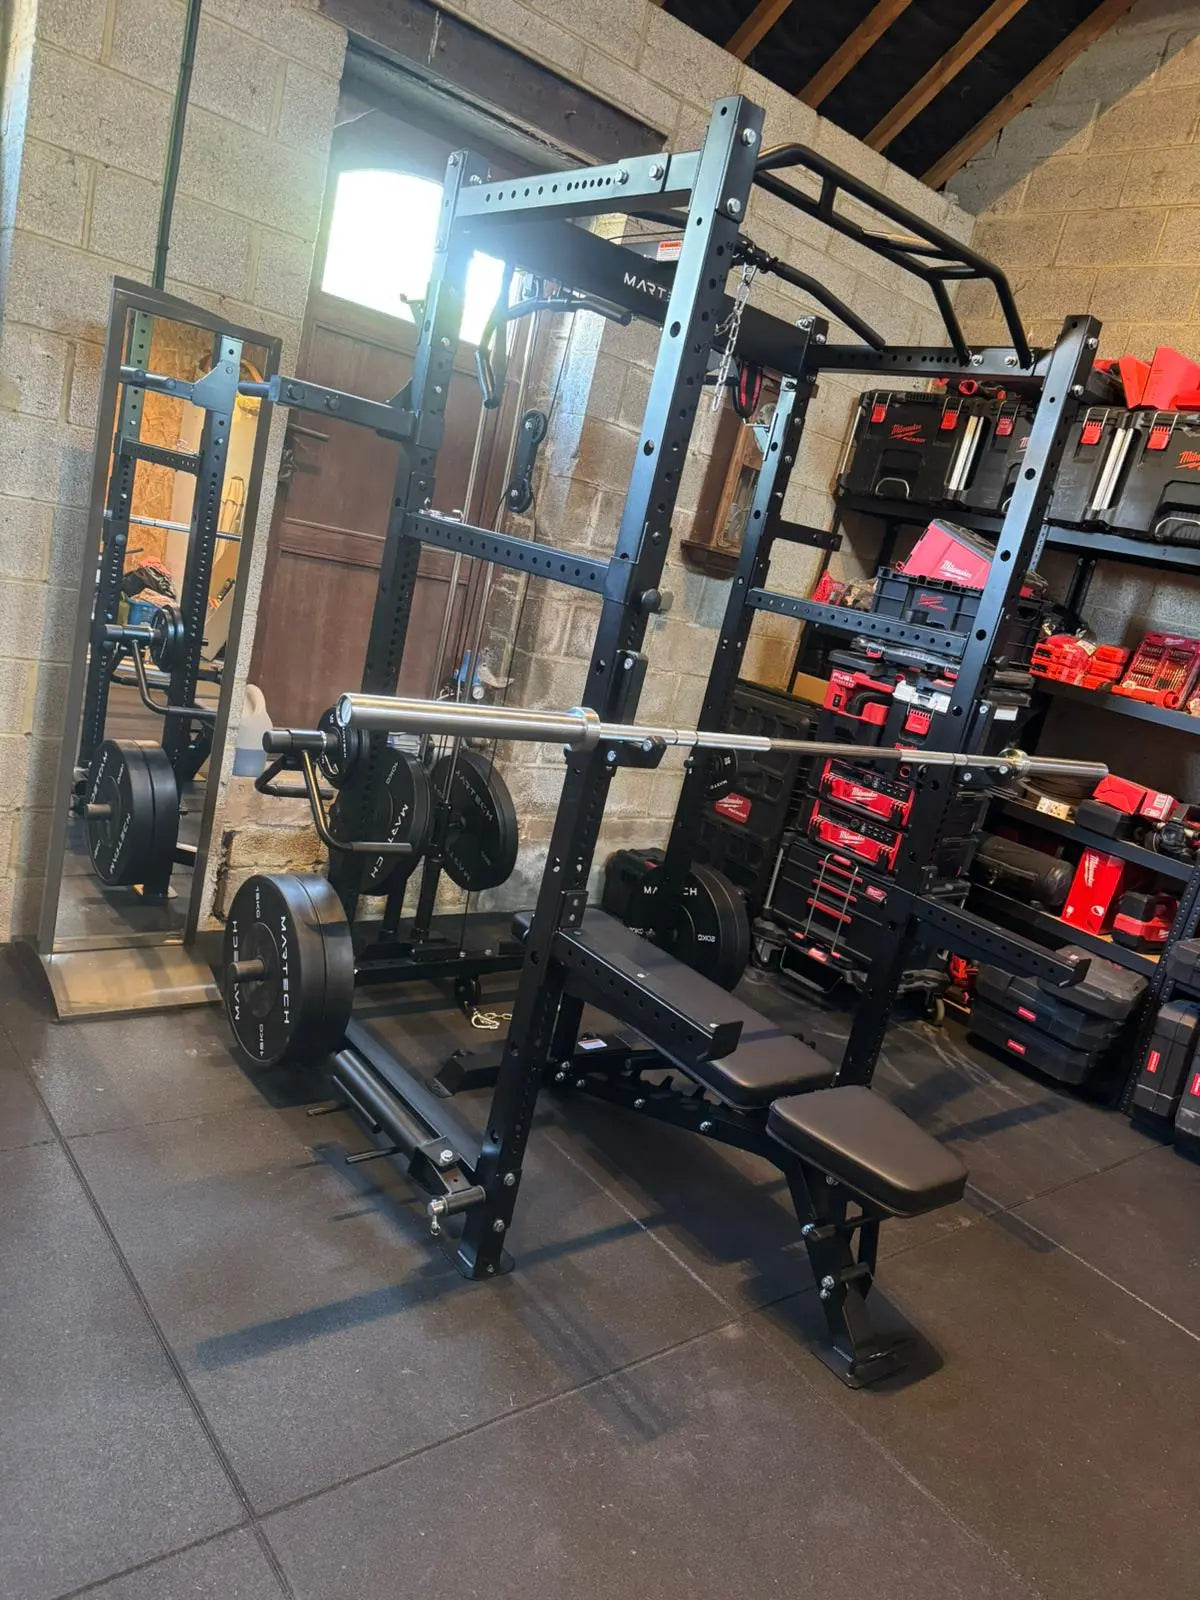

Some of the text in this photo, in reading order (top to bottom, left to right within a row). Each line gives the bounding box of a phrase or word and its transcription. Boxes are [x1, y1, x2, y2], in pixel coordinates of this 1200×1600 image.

[623, 271, 671, 301] MART
[370, 803, 409, 879] MARTCH
[643, 885, 698, 897] MACH
[232, 919, 241, 1021] MARECH
[279, 915, 291, 1025] MARTECH
